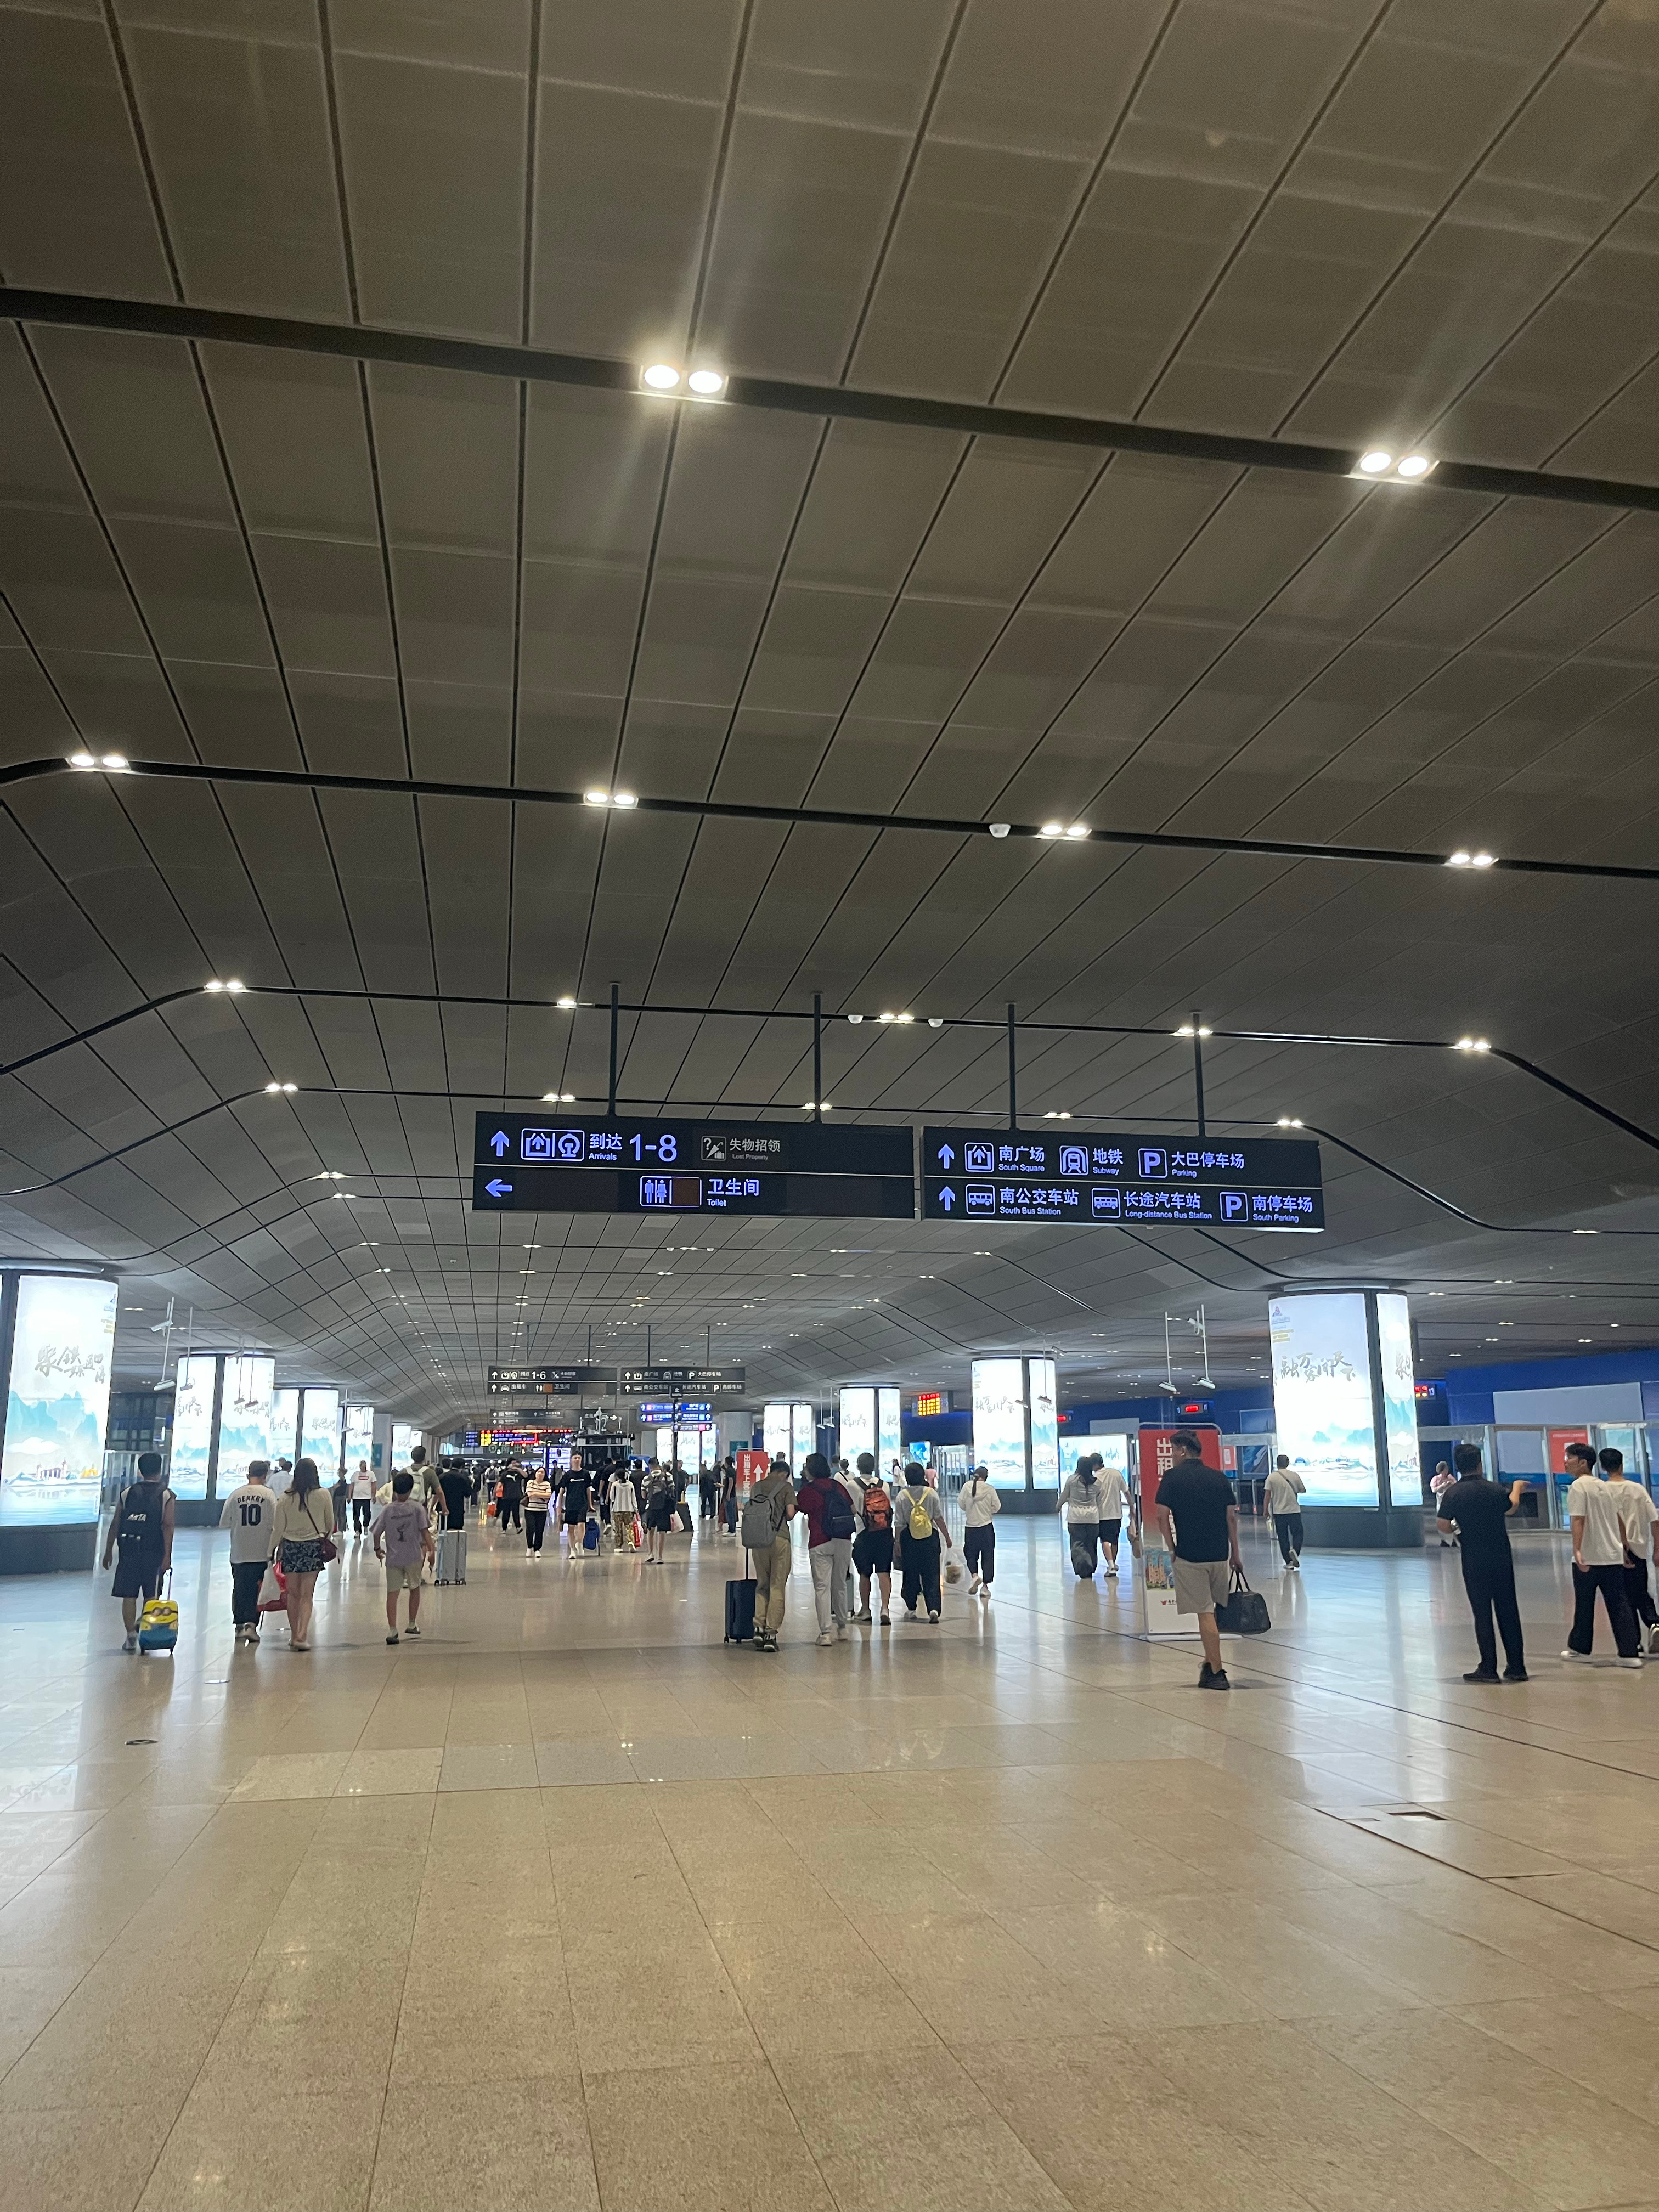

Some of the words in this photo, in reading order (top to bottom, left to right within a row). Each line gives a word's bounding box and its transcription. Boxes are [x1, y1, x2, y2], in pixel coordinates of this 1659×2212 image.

[589, 1133, 623, 1150] 到达
[629, 1133, 677, 1162] 1-8
[729, 1138, 781, 1152] 失物招领
[998, 1145, 1045, 1162] 南广场
[1092, 1148, 1124, 1164] 地铁
[1171, 1151, 1244, 1169] 大巴停车场
[1020, 1164, 1045, 1172] Square
[1092, 1166, 1119, 1176] Subway
[1172, 1169, 1197, 1178] Parking
[707, 1178, 759, 1196] 卫生间
[1000, 1187, 1079, 1205] 南公交车站
[1123, 1190, 1201, 1209] 长途汽车站
[1252, 1195, 1313, 1212] 南停车场
[1125, 1210, 1173, 1219] Long-distance
[1189, 1211, 1212, 1220] Station
[1252, 1213, 1273, 1221] South
[1273, 1214, 1299, 1223] Parking
[531, 1370, 546, 1380] 1-6
[239, 1504, 261, 1526] 10
